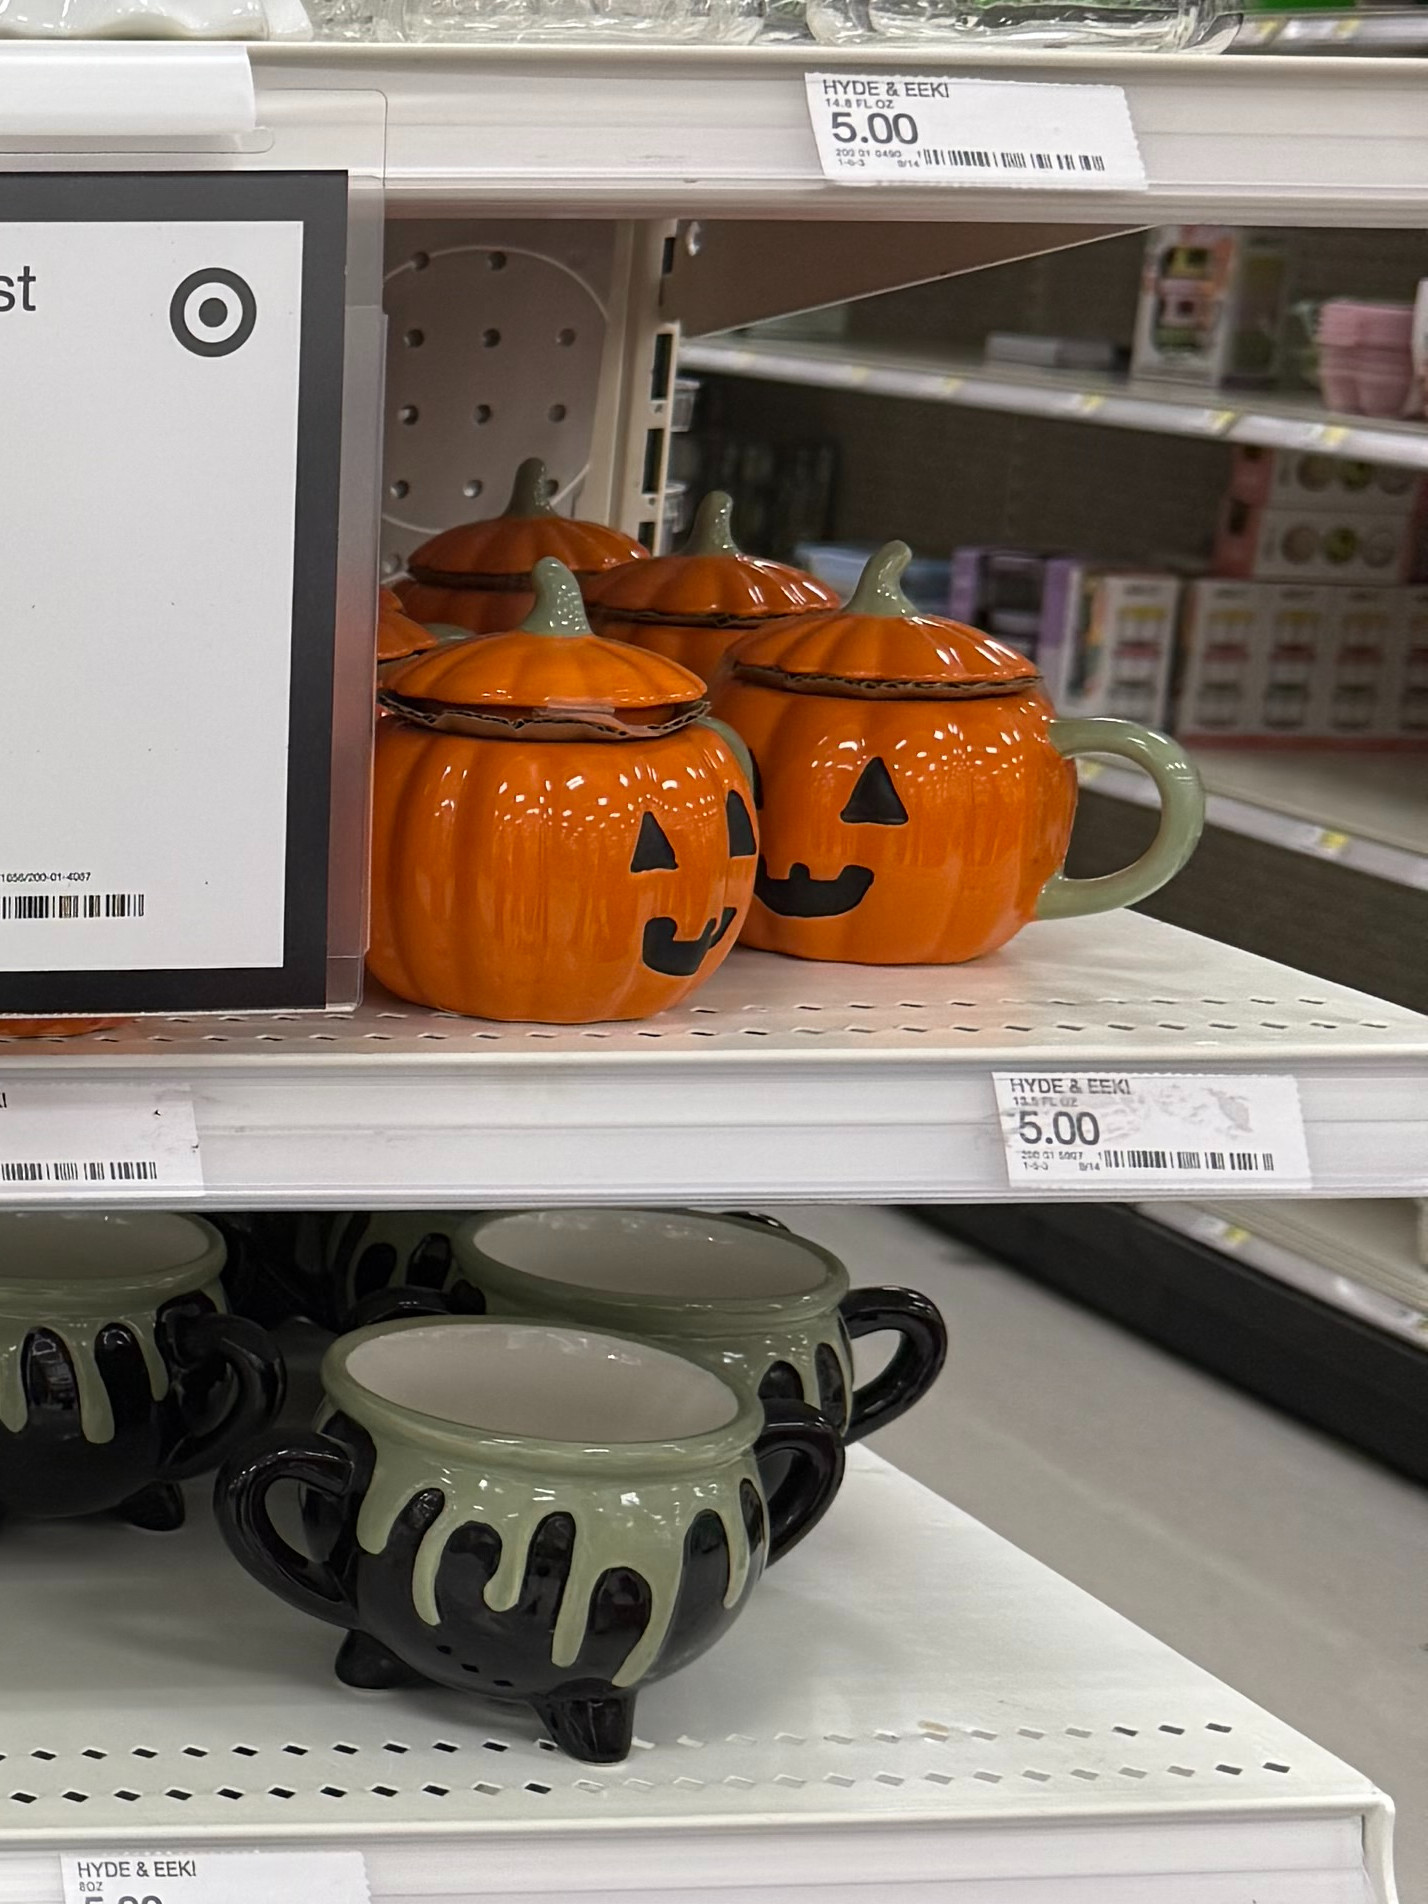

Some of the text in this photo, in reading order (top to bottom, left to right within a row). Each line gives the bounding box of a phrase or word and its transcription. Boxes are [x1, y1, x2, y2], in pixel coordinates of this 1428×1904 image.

[823, 80, 880, 95] HYDE
[886, 82, 899, 96] &
[856, 99, 872, 109] FL
[876, 100, 893, 109] OZ
[831, 112, 918, 144] 5.00
[1010, 1079, 1064, 1093] HYDE
[1070, 1079, 1082, 1093] &
[1019, 1110, 1100, 1145] 5.00
[78, 1861, 131, 1878] HYDE
[136, 1862, 149, 1877] &
